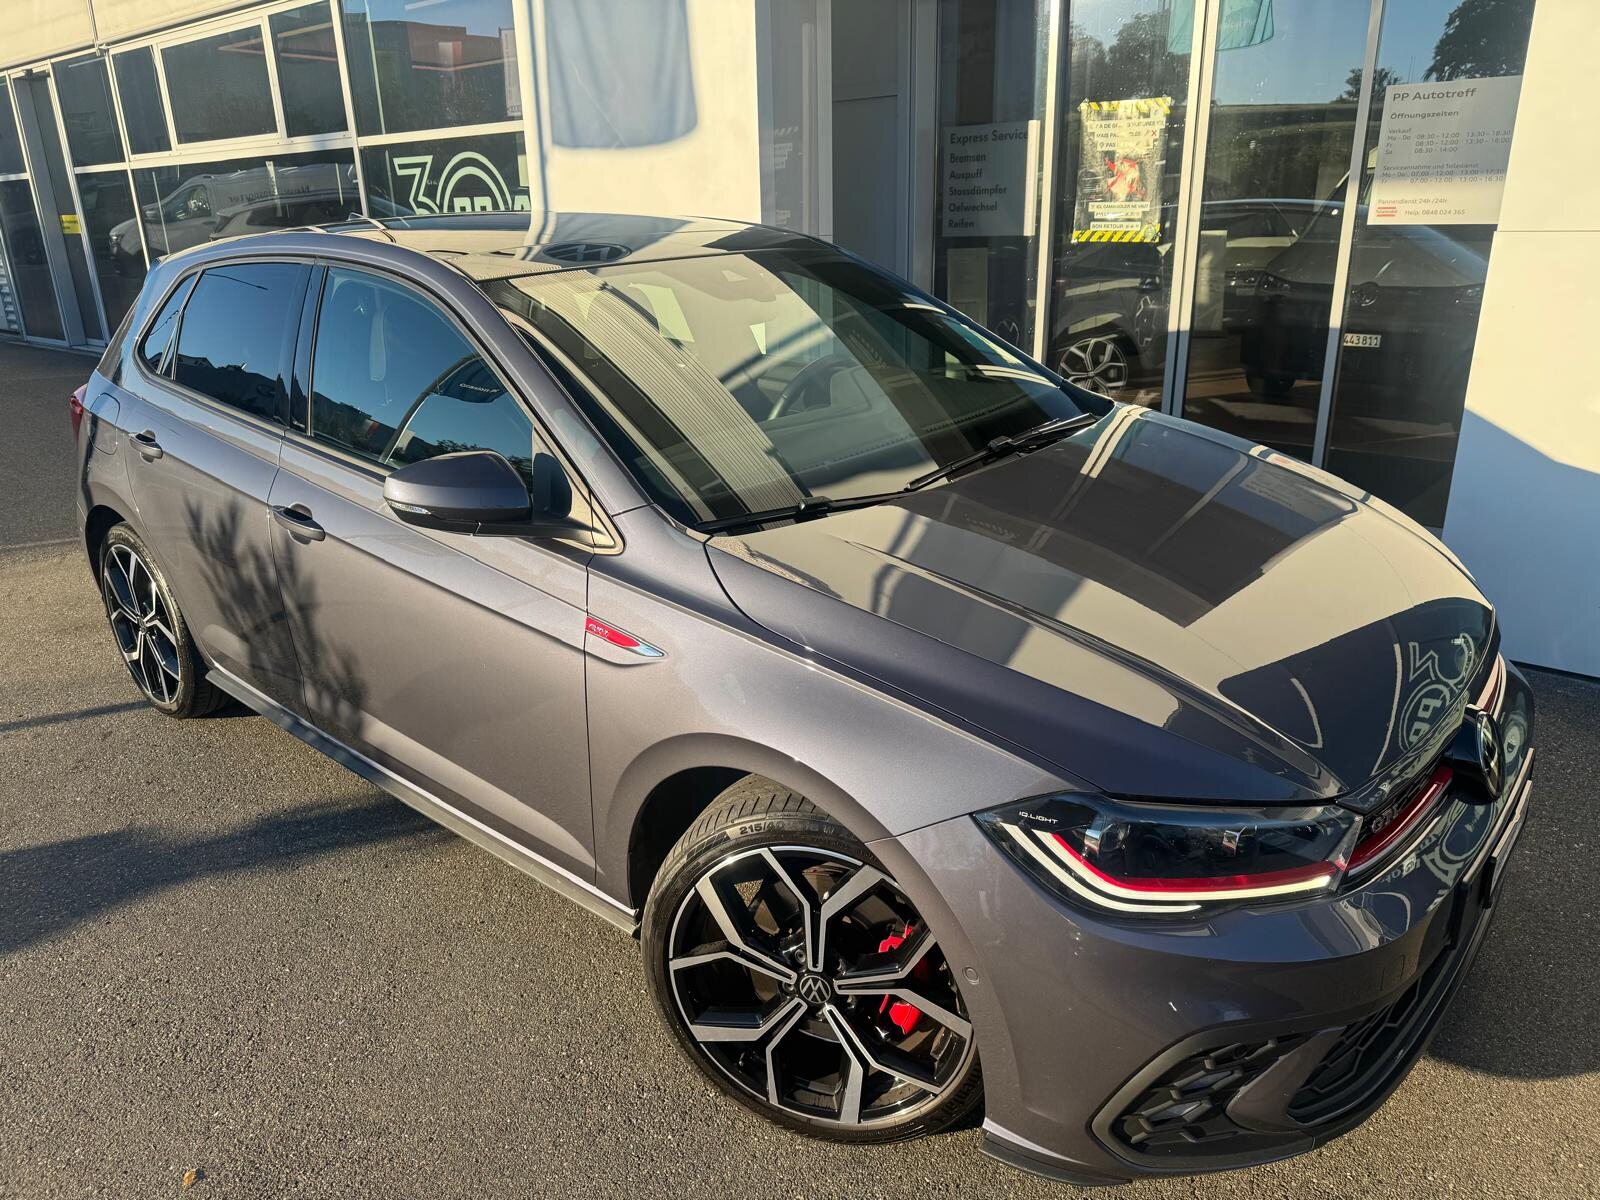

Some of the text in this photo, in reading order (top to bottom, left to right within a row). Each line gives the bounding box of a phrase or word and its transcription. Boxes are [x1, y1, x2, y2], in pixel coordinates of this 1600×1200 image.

[1392, 88, 1477, 102] PP Autotreff
[1390, 110, 1459, 120] Öffnungszeiten
[950, 132, 989, 146] Express
[949, 152, 986, 164] Bremsen
[949, 168, 983, 181] Auspuff
[948, 184, 1007, 197] Stossdämpfer
[948, 201, 998, 213] Oelwechsel
[948, 219, 975, 229] Reifen
[1343, 335, 1379, 346] 443811
[1019, 810, 1059, 824] IQ.LIGHT
